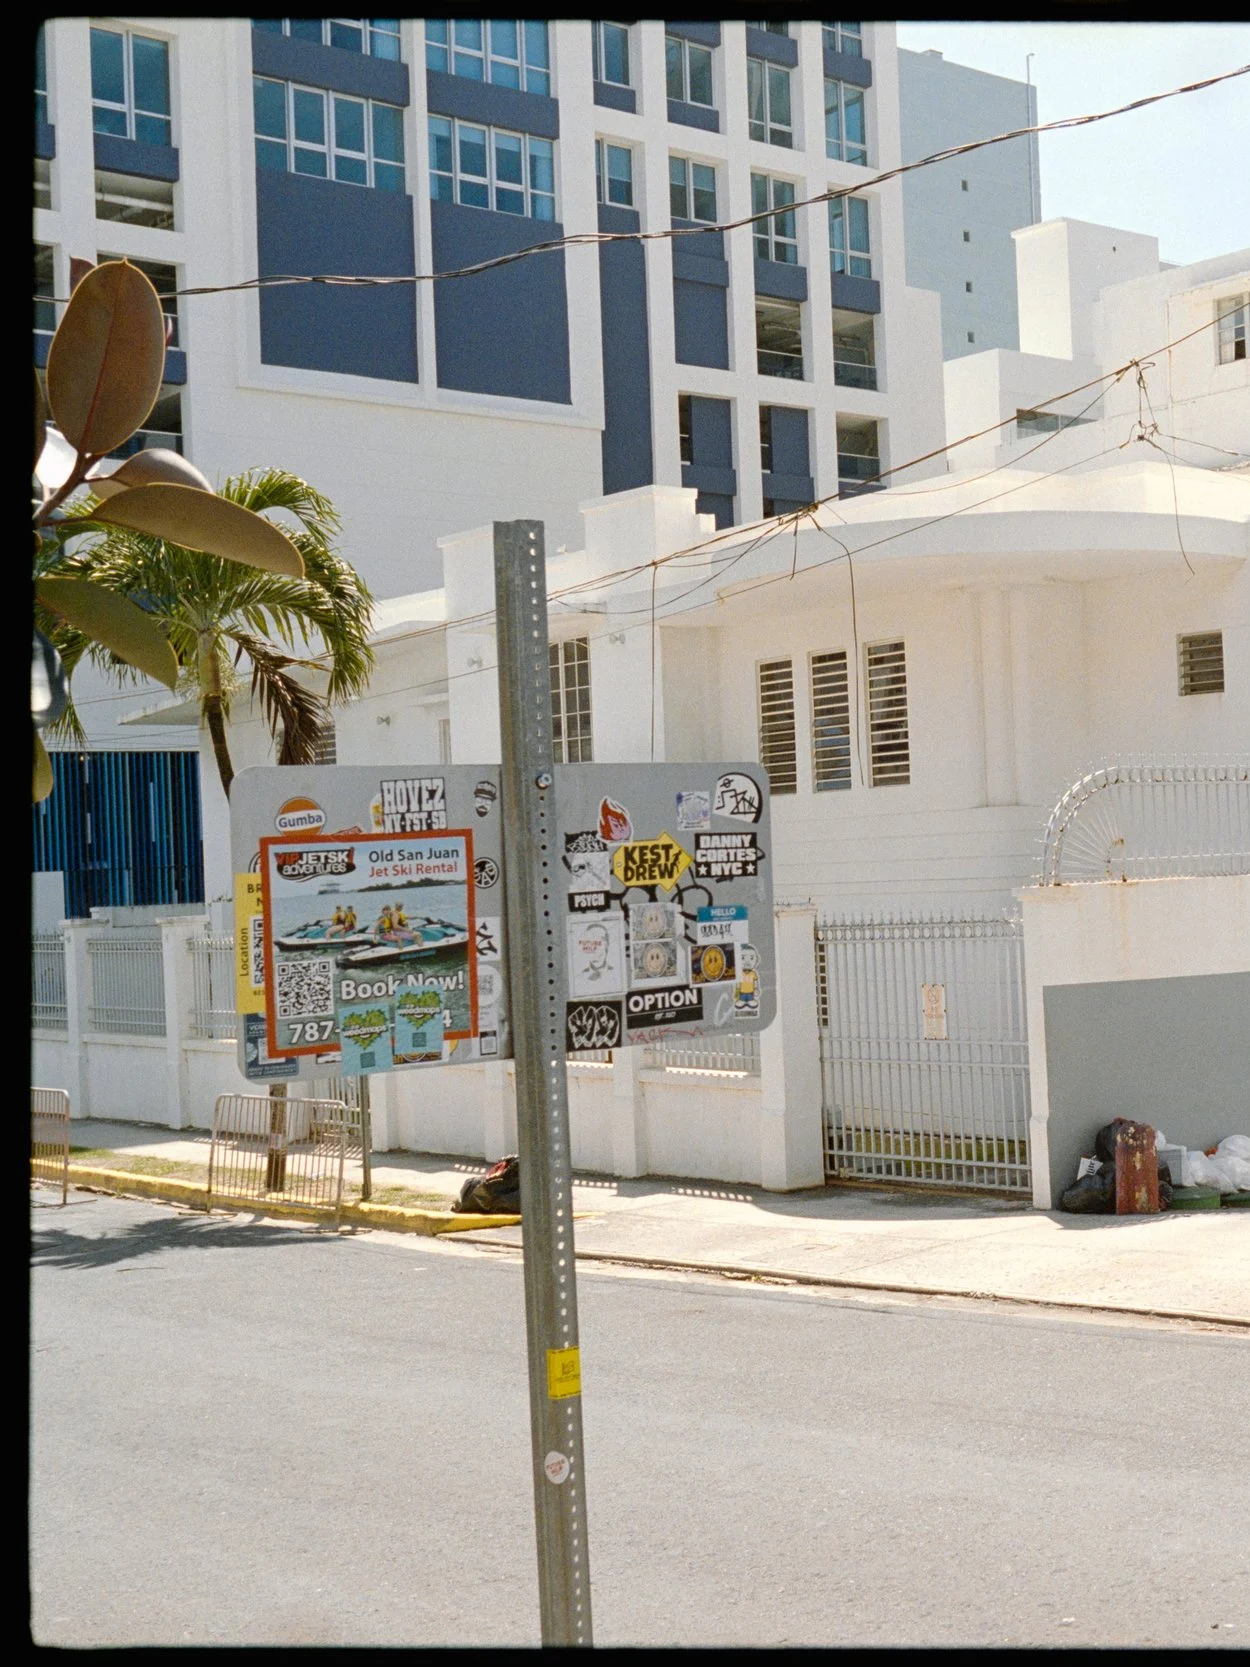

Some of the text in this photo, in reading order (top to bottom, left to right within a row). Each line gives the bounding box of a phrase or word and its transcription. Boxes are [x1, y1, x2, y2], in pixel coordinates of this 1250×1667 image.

[278, 813, 322, 828] Gumba
[699, 834, 753, 848] DANNY
[368, 848, 459, 863] Old San Juan
[623, 844, 673, 865] KEST
[695, 847, 757, 863] CORTES
[282, 862, 346, 876] adventures
[369, 861, 458, 878] Jet Ski Rental
[623, 863, 676, 882] DREW
[710, 862, 743, 876] NYC
[710, 907, 737, 917] HELLO
[239, 927, 249, 977] Location
[340, 974, 400, 1000] Book
[628, 989, 698, 1013] OPTION
